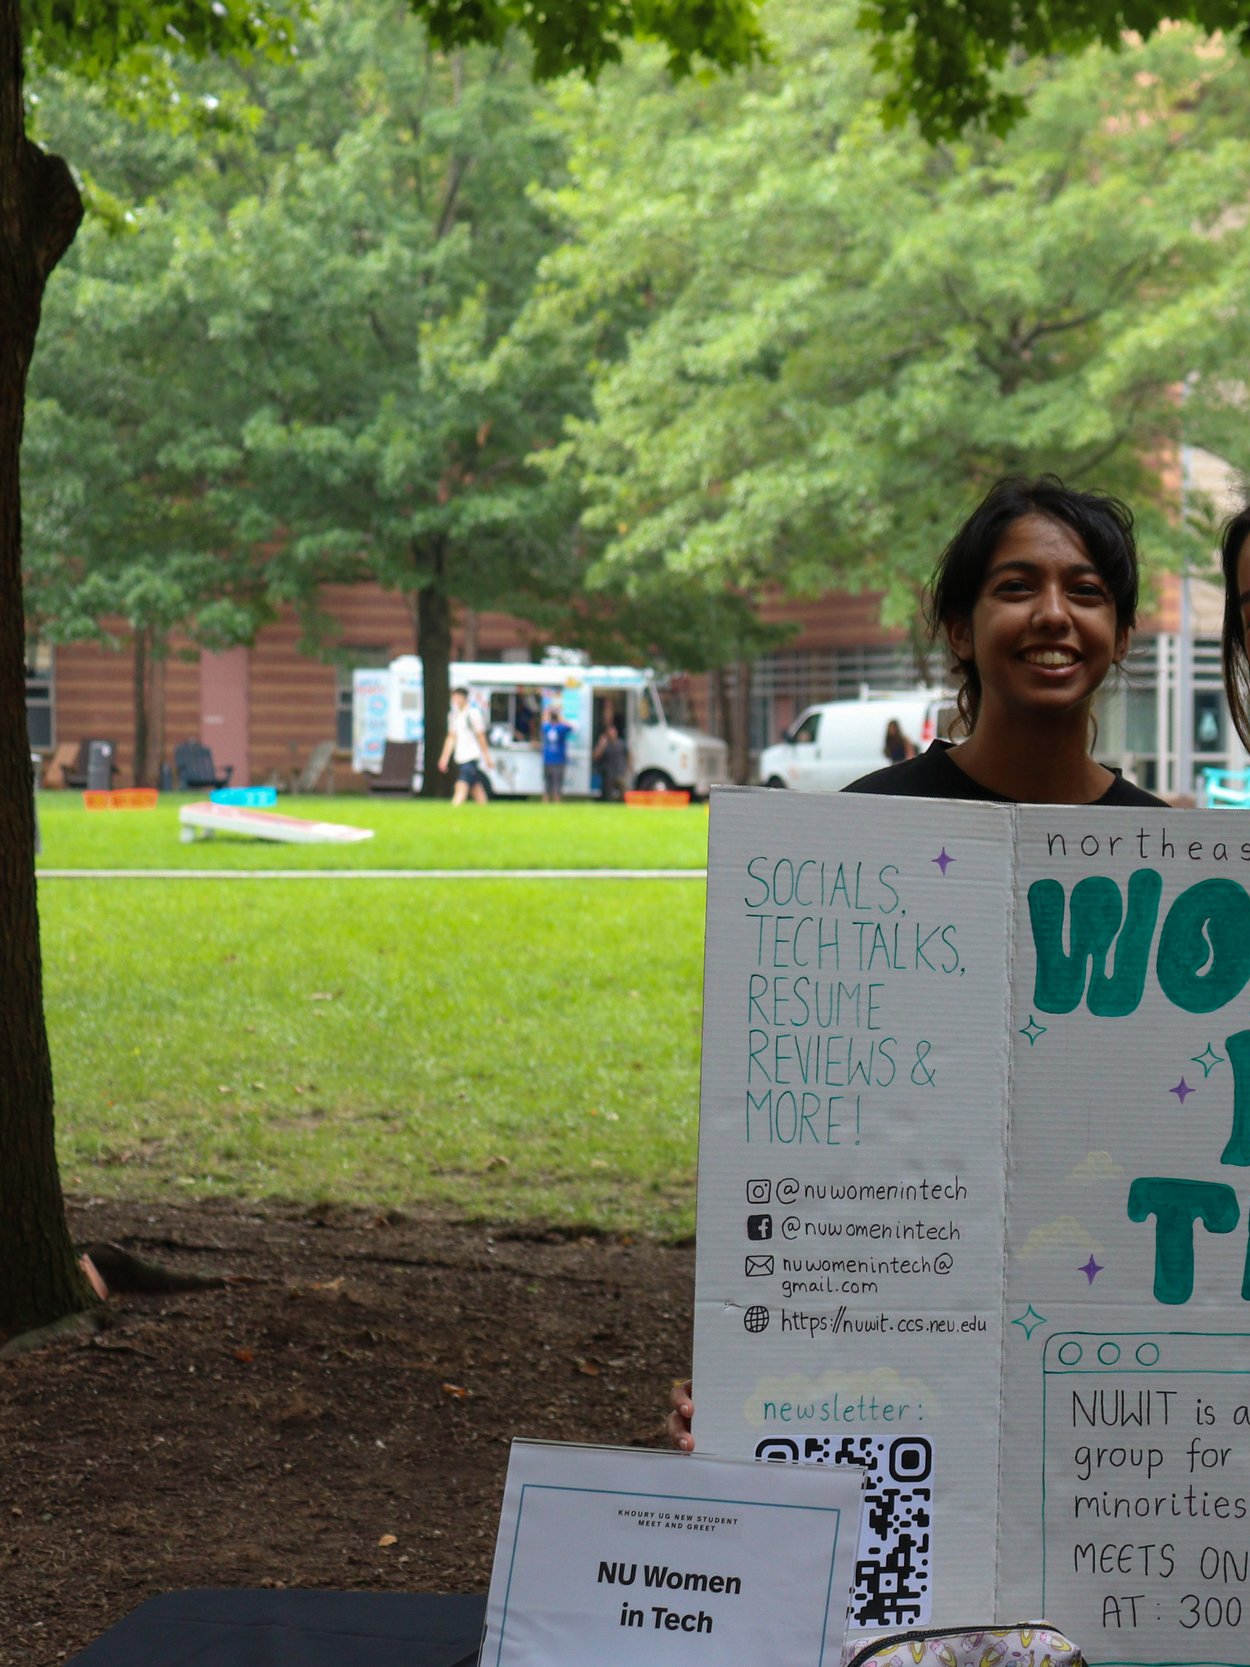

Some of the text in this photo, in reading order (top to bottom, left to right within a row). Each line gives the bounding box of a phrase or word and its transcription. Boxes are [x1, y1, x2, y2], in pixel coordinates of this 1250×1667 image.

[745, 856, 907, 918] SOCIALS,
[745, 914, 966, 977] TECH TALKS,
[748, 974, 885, 1030] RESUME
[748, 1029, 937, 1087] REVIEWS &
[746, 1089, 861, 1146] MORE!
[776, 1176, 968, 1204] @nuwomenintech
[782, 1216, 961, 1240] @nuwomenintech
[783, 1252, 954, 1275] nuwomenintech@
[782, 1276, 878, 1298] gmail.com
[781, 1305, 987, 1338] https://nuwit.ccs.neu.edu
[1072, 1389, 1177, 1428] NUWIT
[1196, 1398, 1216, 1426] is
[1074, 1446, 1164, 1481] group
[1186, 1437, 1232, 1473] for
[618, 1509, 738, 1525] KHOURY UG NEW STUDENT
[1074, 1484, 1247, 1519] minorities
[638, 1520, 662, 1528] MEET
[686, 1523, 716, 1532] GREET
[597, 1561, 742, 1595] NU Women
[1073, 1543, 1175, 1578] MEETS
[1200, 1547, 1249, 1583] ON
[620, 1602, 713, 1634] in Tech
[1179, 1594, 1242, 1629] 300
